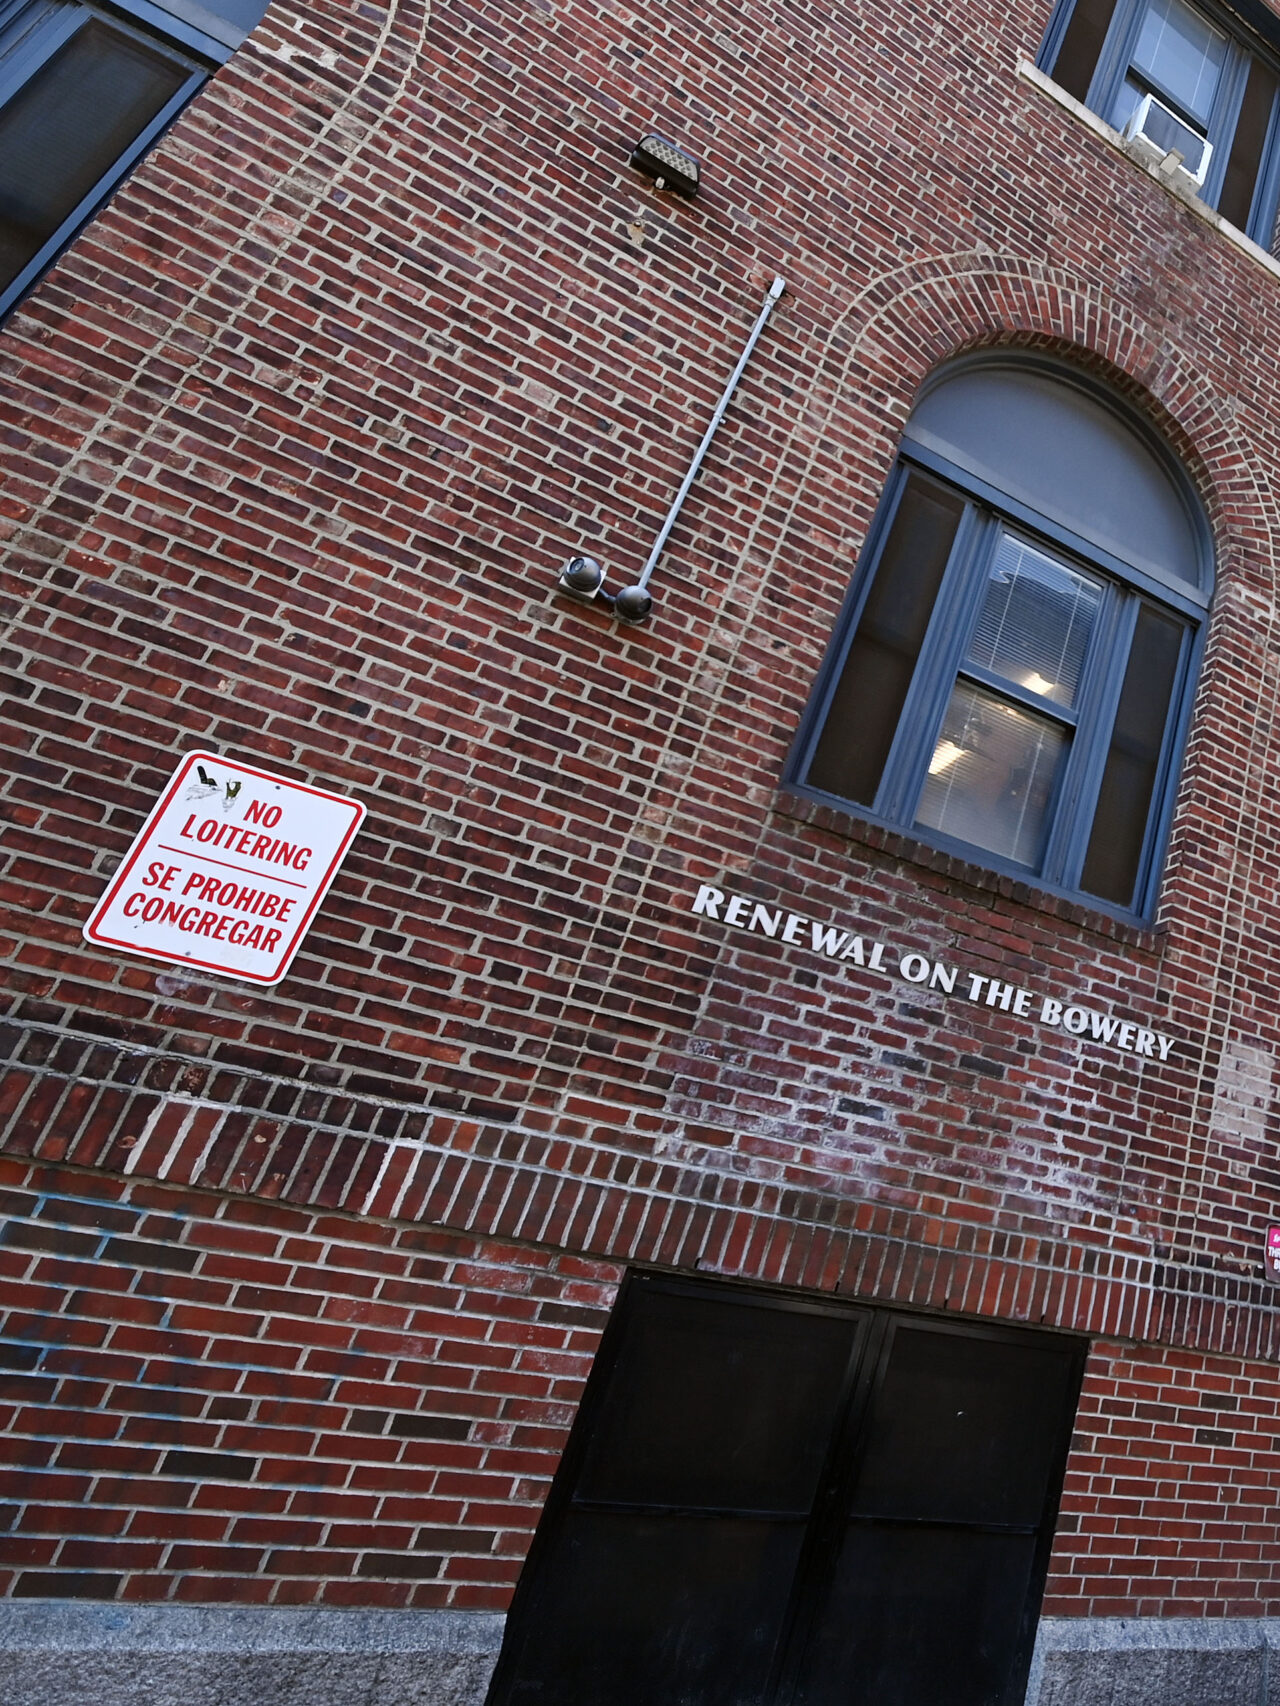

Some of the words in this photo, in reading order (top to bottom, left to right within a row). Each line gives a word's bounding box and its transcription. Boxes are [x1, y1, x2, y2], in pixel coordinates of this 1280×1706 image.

[179, 814, 312, 872] LOITERING
[243, 800, 283, 828] NO
[123, 892, 282, 953] CONGREGAR
[142, 861, 182, 892] SE
[181, 872, 297, 923] PROHIBE
[691, 884, 887, 973] RENEWAL
[899, 953, 959, 994] ON
[967, 972, 1033, 1018] THE
[1039, 998, 1175, 1061] BOWERY
